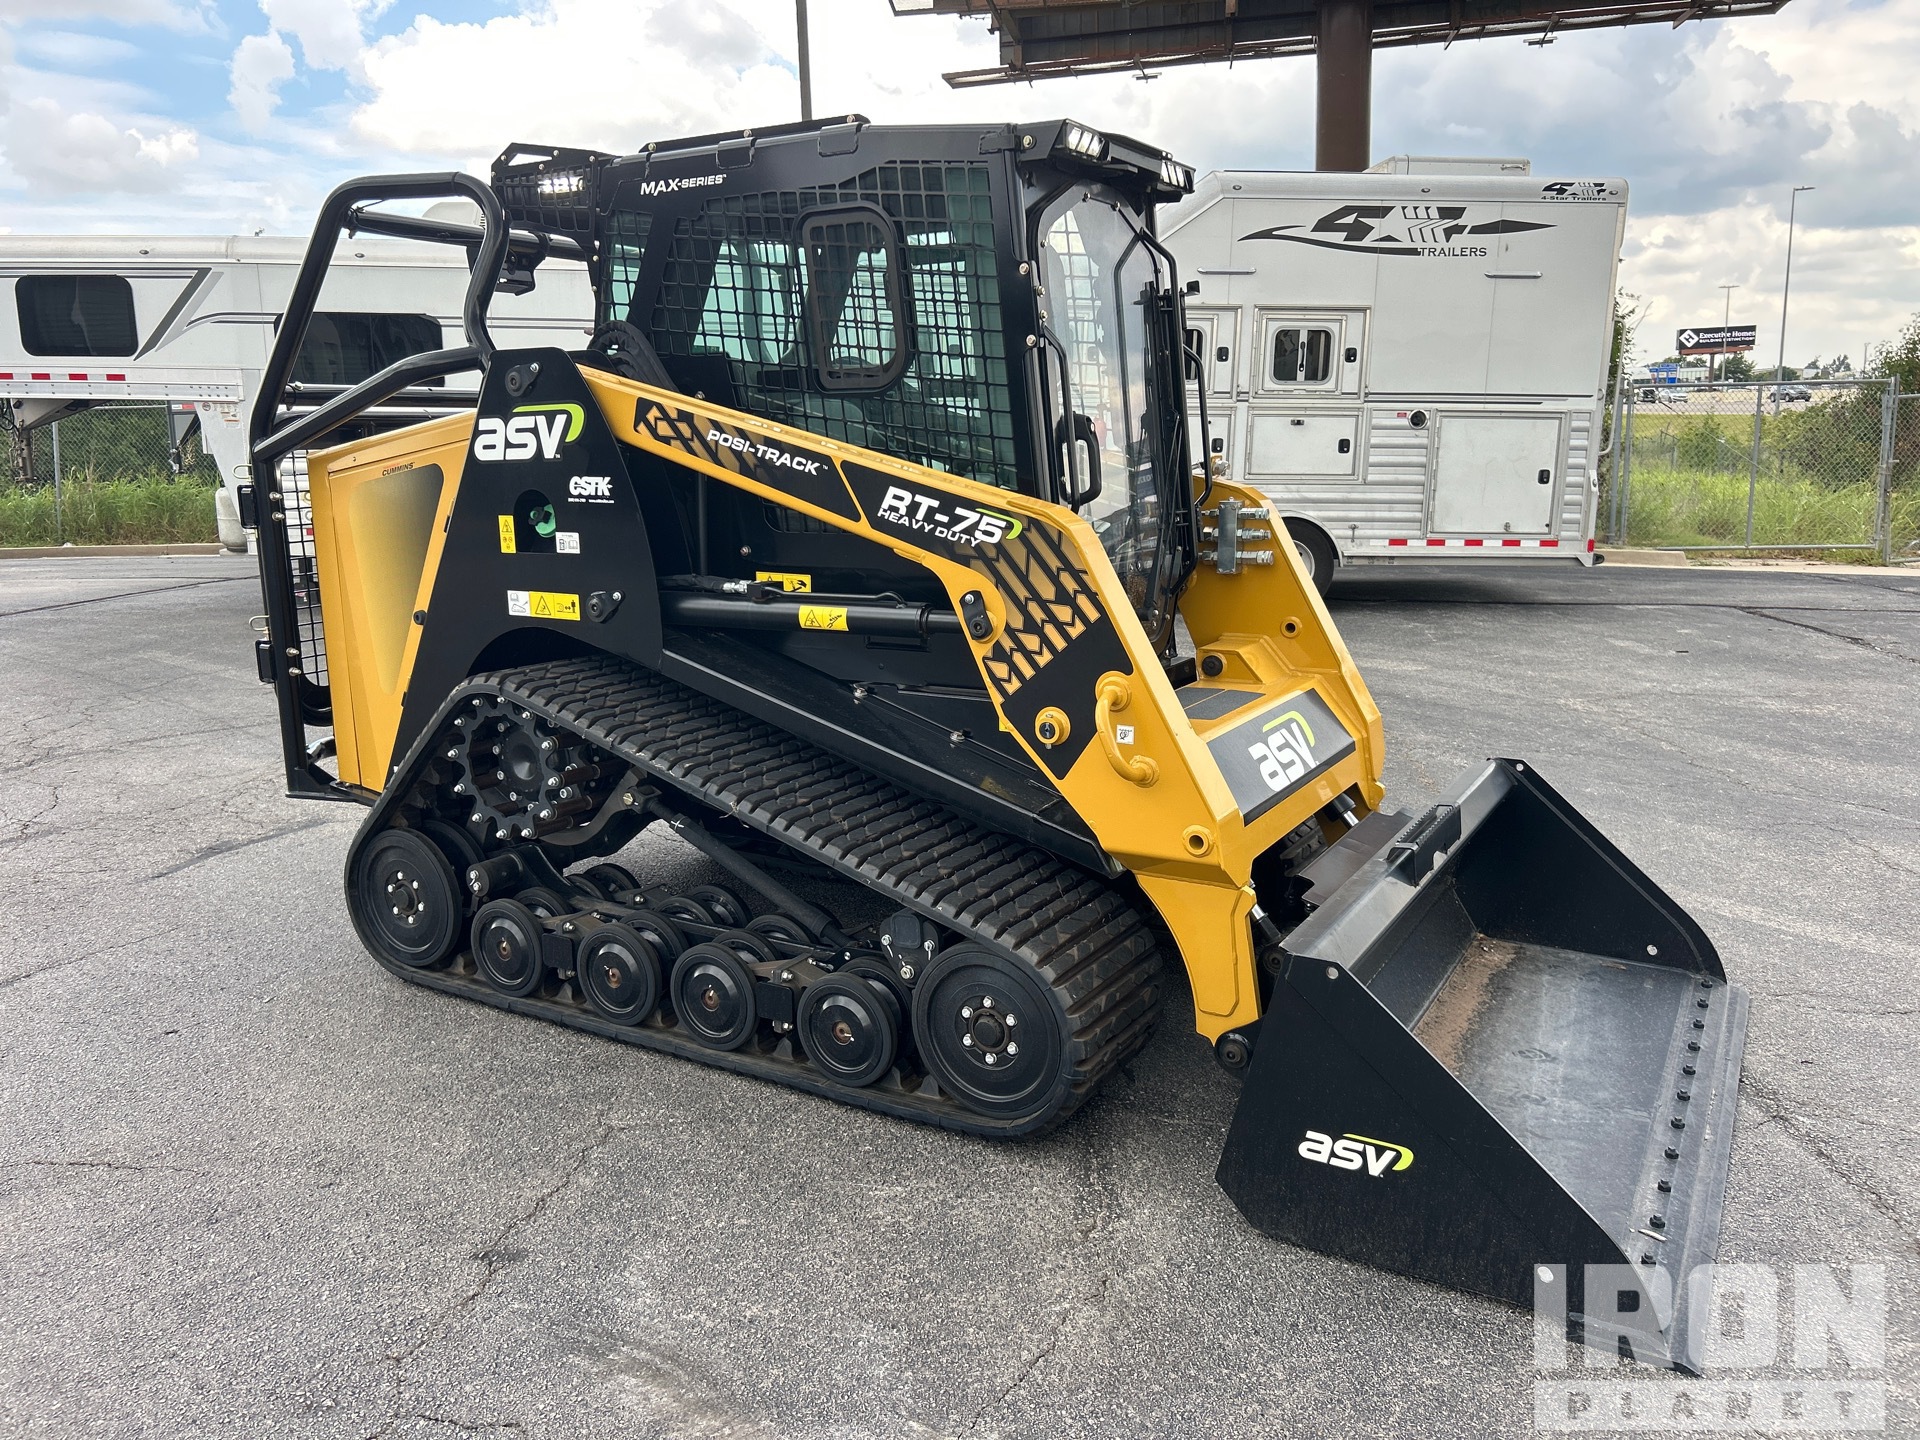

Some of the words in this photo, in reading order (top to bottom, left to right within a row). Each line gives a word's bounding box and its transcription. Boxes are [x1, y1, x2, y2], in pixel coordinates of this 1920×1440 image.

[1420, 246, 1488, 257] TRAILERS
[382, 462, 414, 477] CUMMINS
[877, 507, 934, 533] HEAVY
[935, 526, 981, 548] DUTY
[880, 486, 1007, 544] RT-75
